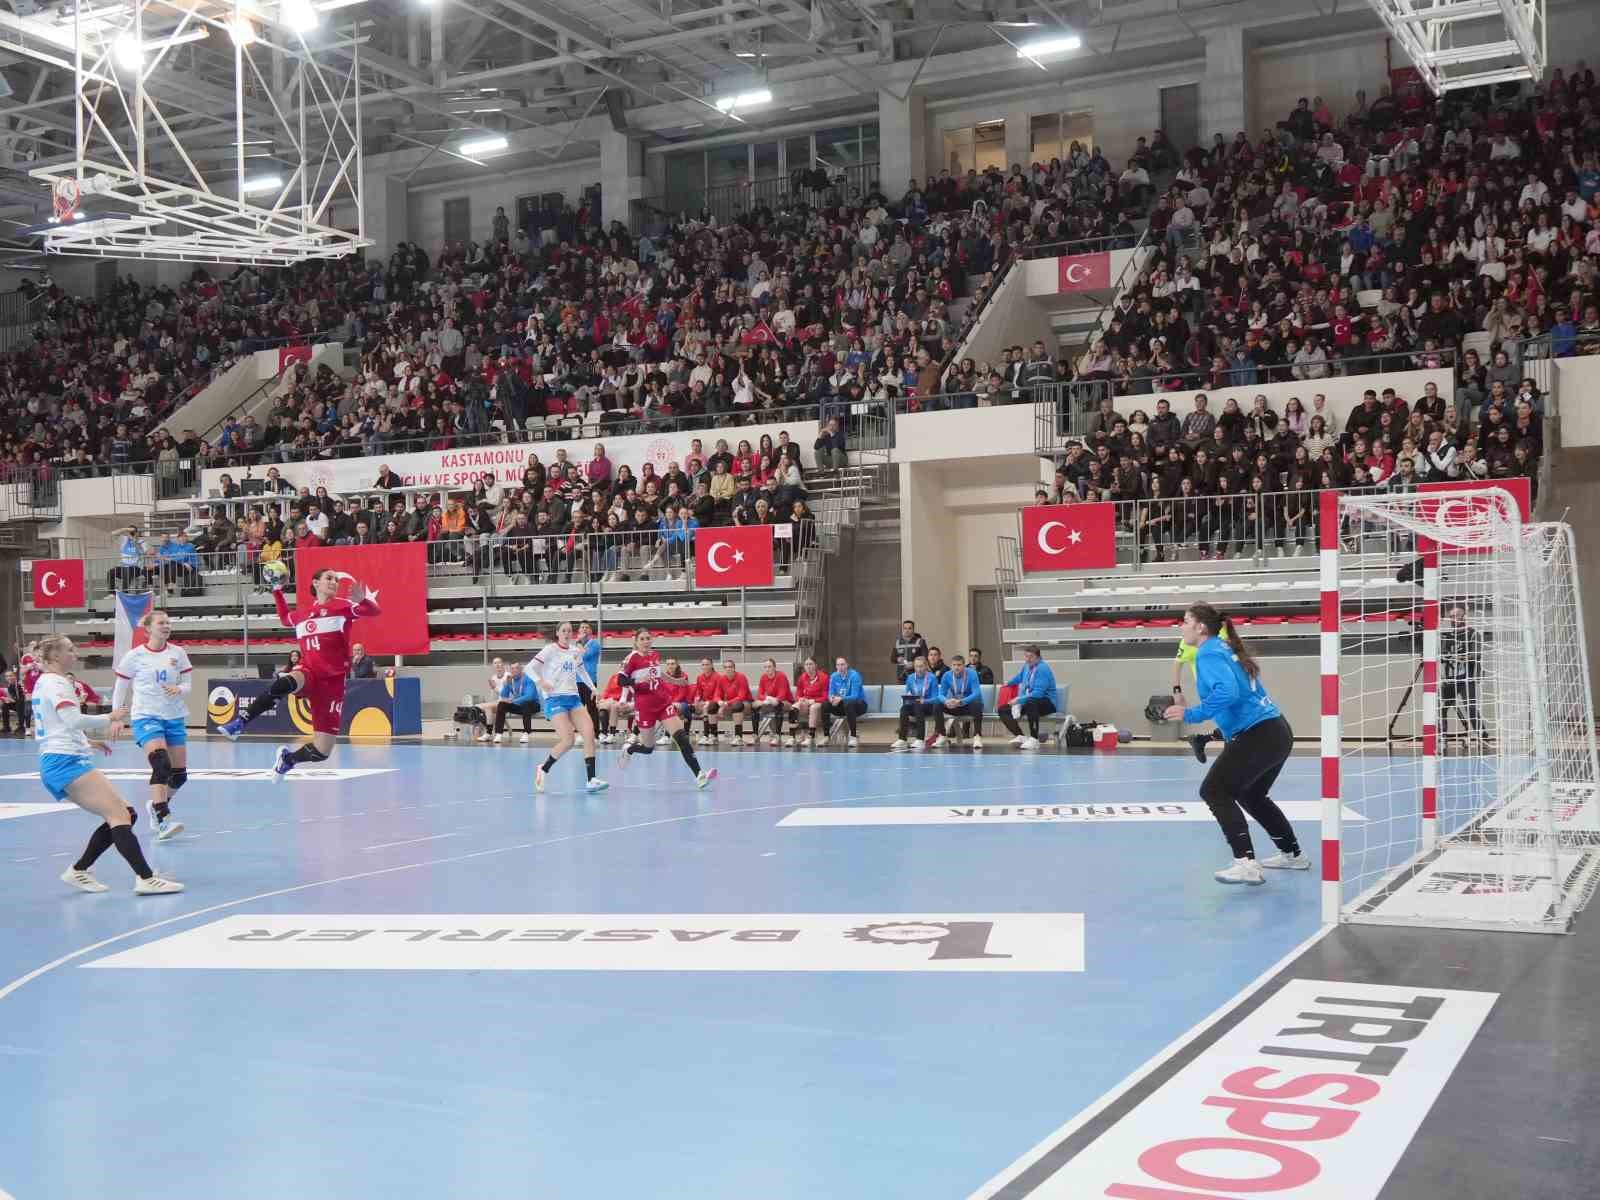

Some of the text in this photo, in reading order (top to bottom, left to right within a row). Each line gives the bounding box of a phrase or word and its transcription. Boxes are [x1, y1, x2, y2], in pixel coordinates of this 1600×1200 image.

[442, 450, 524, 468] KASTAMONU
[435, 473, 450, 486] VE
[305, 636, 321, 651] 14
[155, 669, 167, 683] 14
